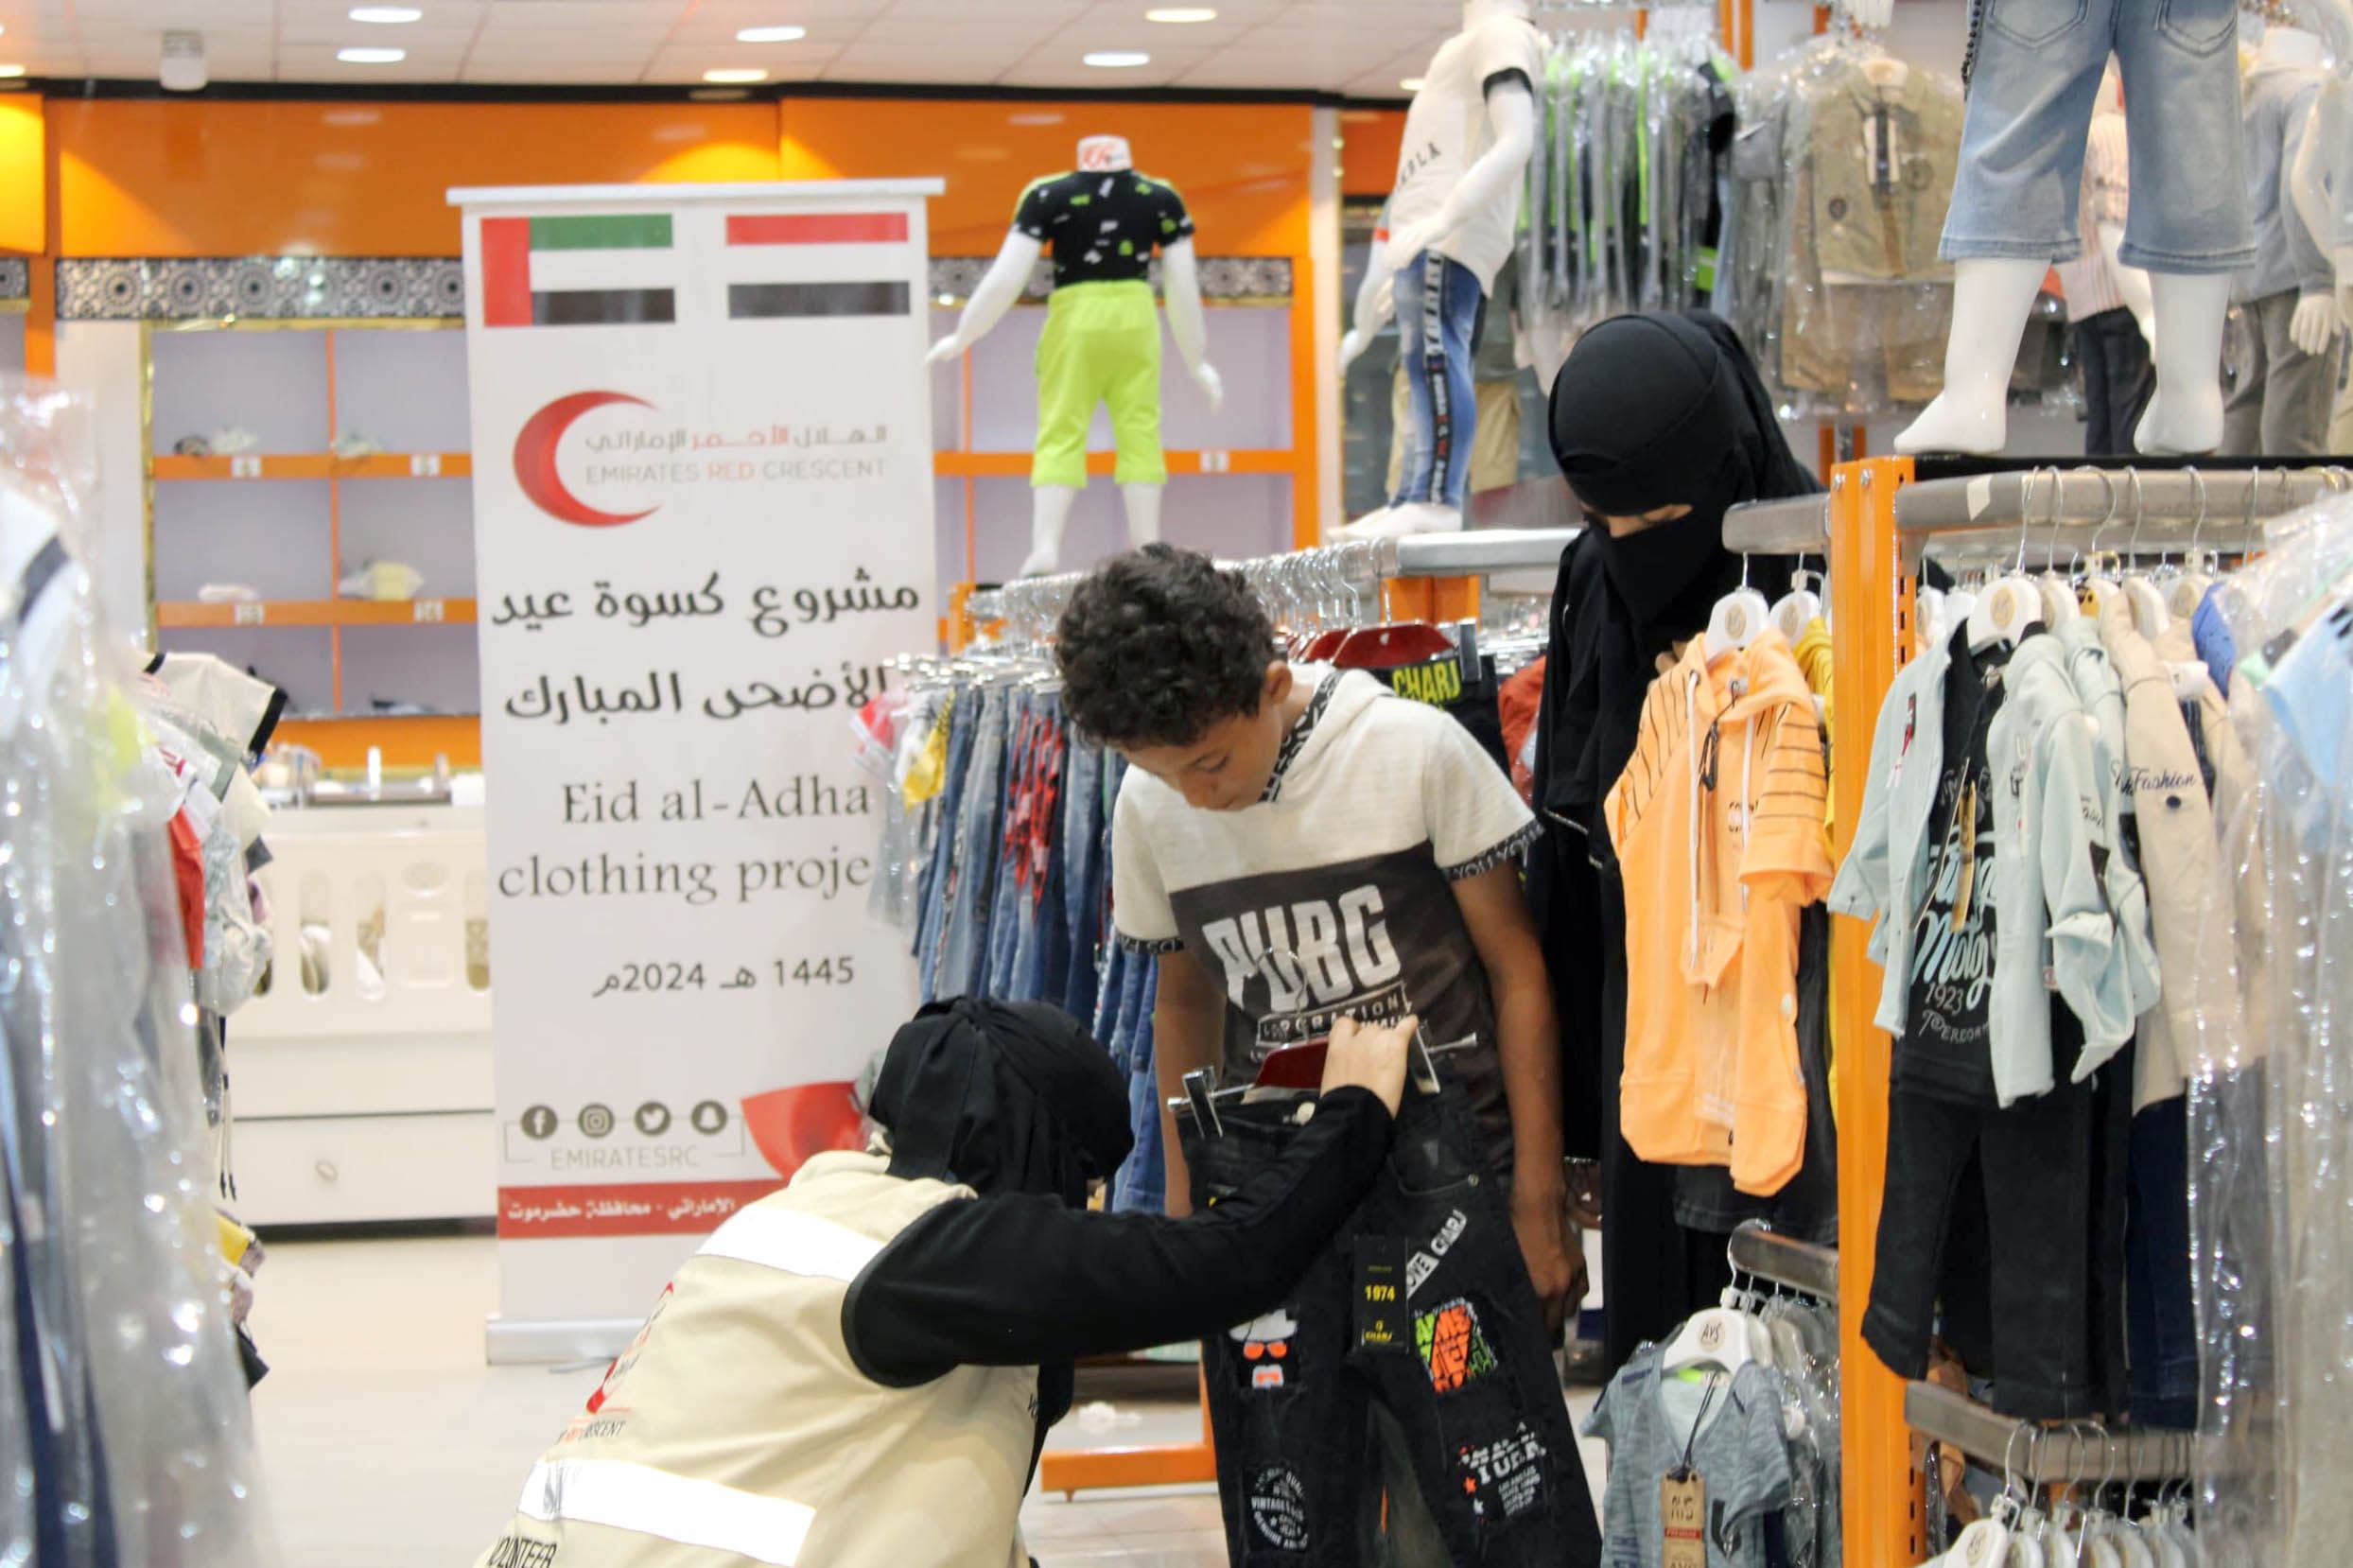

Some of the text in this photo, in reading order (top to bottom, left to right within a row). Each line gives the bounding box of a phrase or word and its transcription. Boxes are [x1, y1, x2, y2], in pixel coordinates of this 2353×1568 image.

[585, 458, 886, 484] EMIRATES RED CRESCENT
[492, 566, 920, 638] مشروع كسوة عيد
[504, 661, 887, 725] الأضحى المبارك
[1392, 659, 1462, 705] CHARJ
[562, 775, 871, 825] Eid al-Adha
[498, 845, 872, 906] clothing proje
[772, 956, 854, 987] 1445
[1201, 884, 1402, 1013] PUBG
[1925, 981, 1964, 1016] 1923
[549, 1144, 700, 1171] EMIRATESRC
